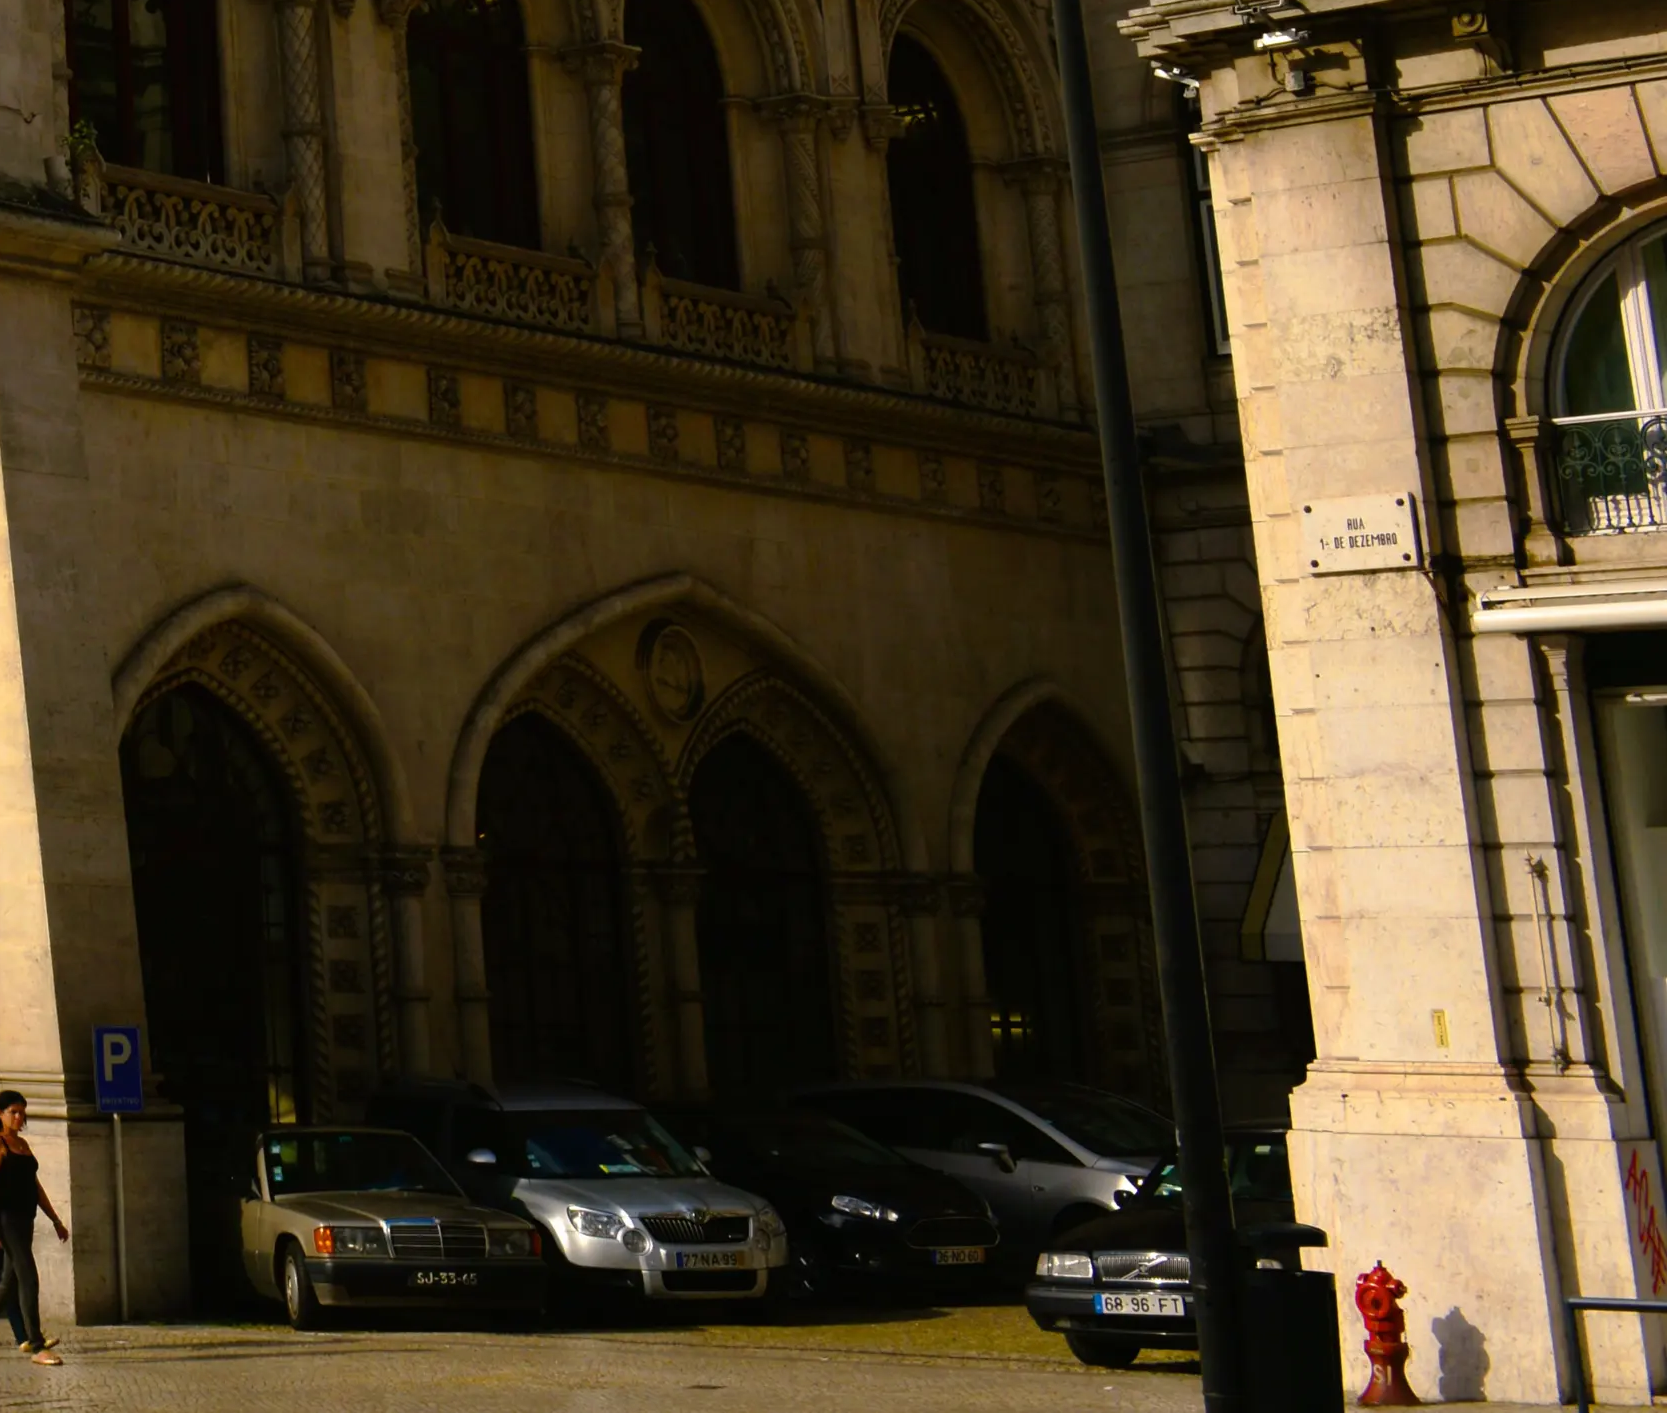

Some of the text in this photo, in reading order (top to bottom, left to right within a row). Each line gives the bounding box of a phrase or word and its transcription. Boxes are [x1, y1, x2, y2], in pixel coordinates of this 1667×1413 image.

[1346, 517, 1365, 530] RUA
[1333, 536, 1345, 549] DE
[1348, 532, 1398, 548] DEZEMBRO
[103, 1033, 132, 1082] P
